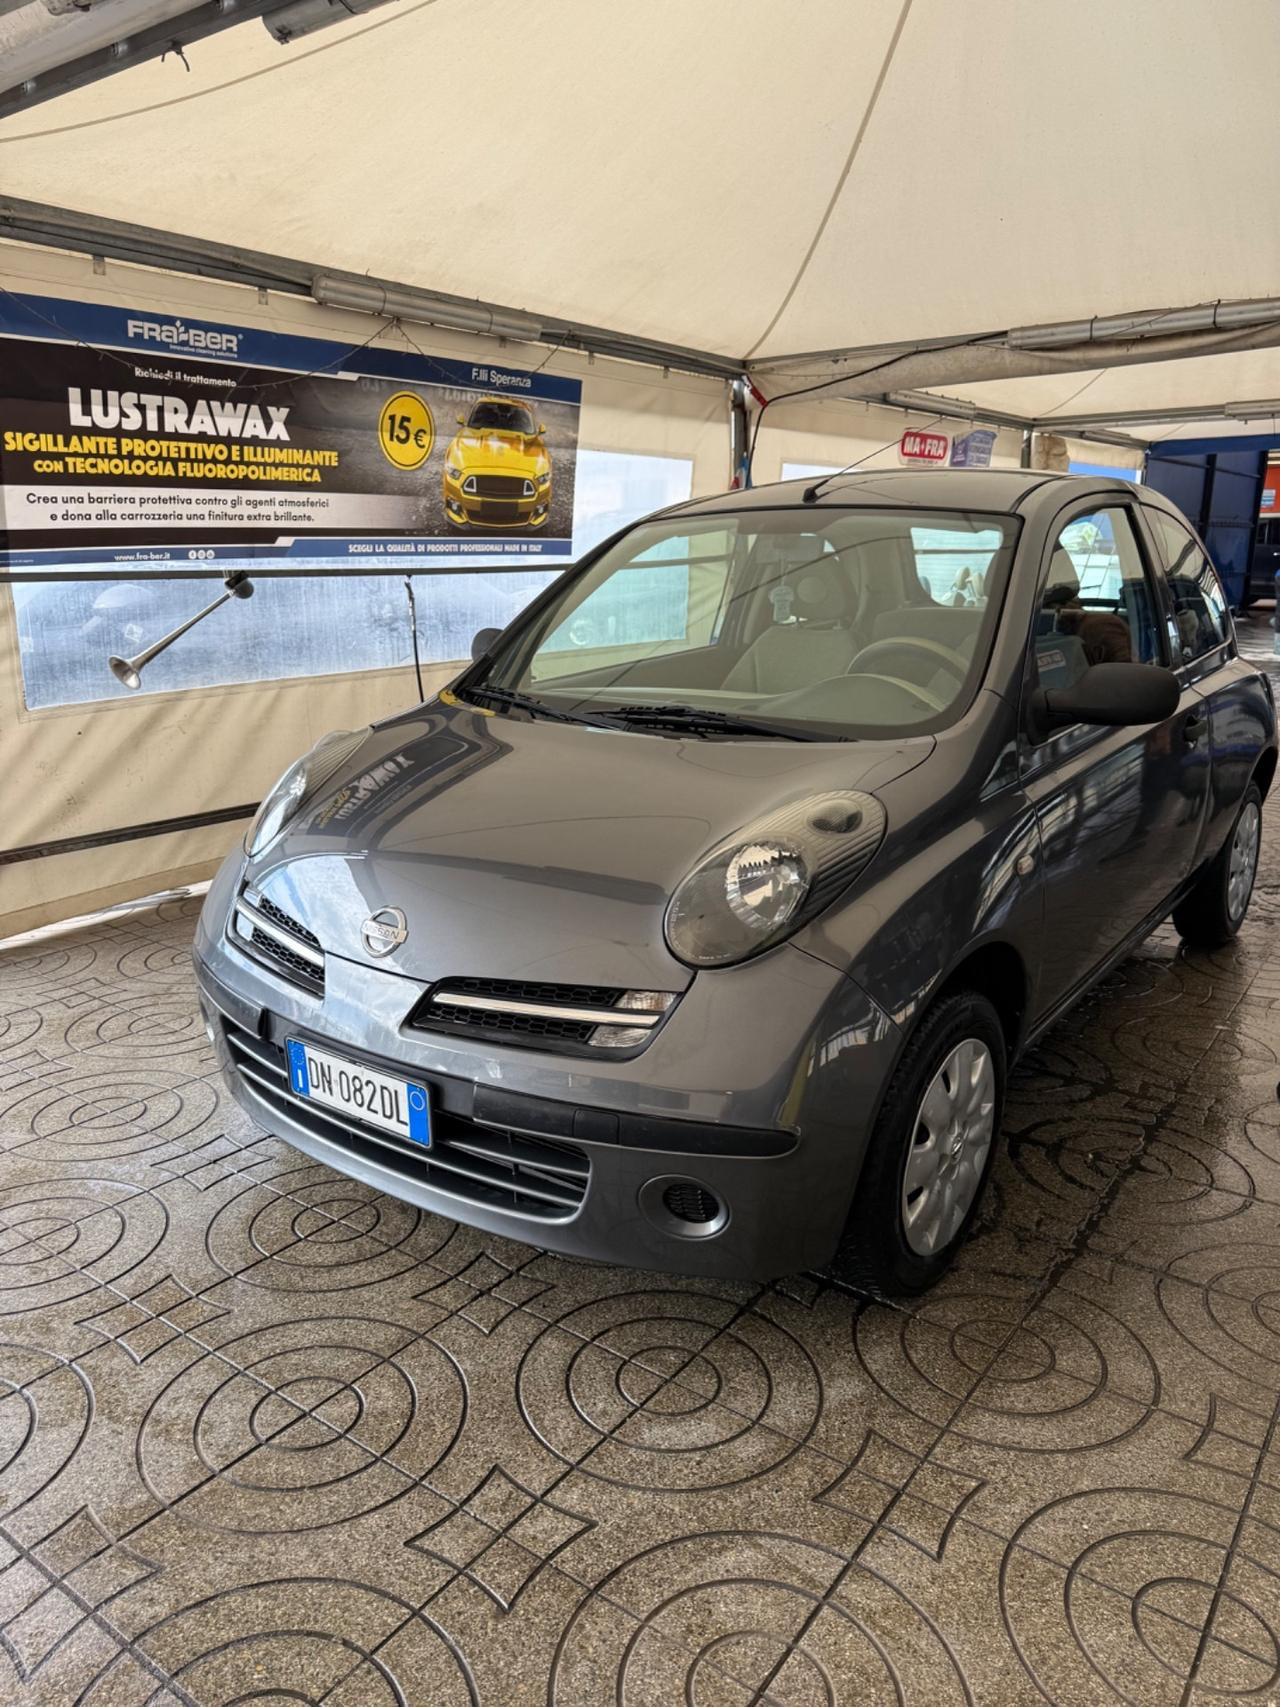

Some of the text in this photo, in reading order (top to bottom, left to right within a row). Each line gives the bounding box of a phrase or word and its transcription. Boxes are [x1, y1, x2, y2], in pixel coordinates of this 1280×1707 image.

[134, 366, 237, 387] Richiedi il trattamento
[490, 370, 532, 388] Speranza
[67, 387, 291, 441] LUSTRAWAX
[4, 431, 339, 466] SIGILLANTE PROTETTIVO E ILLUMINANTE
[65, 457, 176, 476] TECNOLOGIA
[178, 462, 322, 482] FLUOROPOLIMERICA
[26, 493, 329, 508] Crea una barriera protettiva contro gli agenti atmosferici
[50, 509, 315, 522] e dona alla carrozzeria una finitura extra brillante.
[114, 551, 170, 561] www.fra-ber.it
[348, 542, 543, 553] SCEGLI LA QUALITÀ DI PRODOTTI PROFESSIONALI MADE IN ITALY
